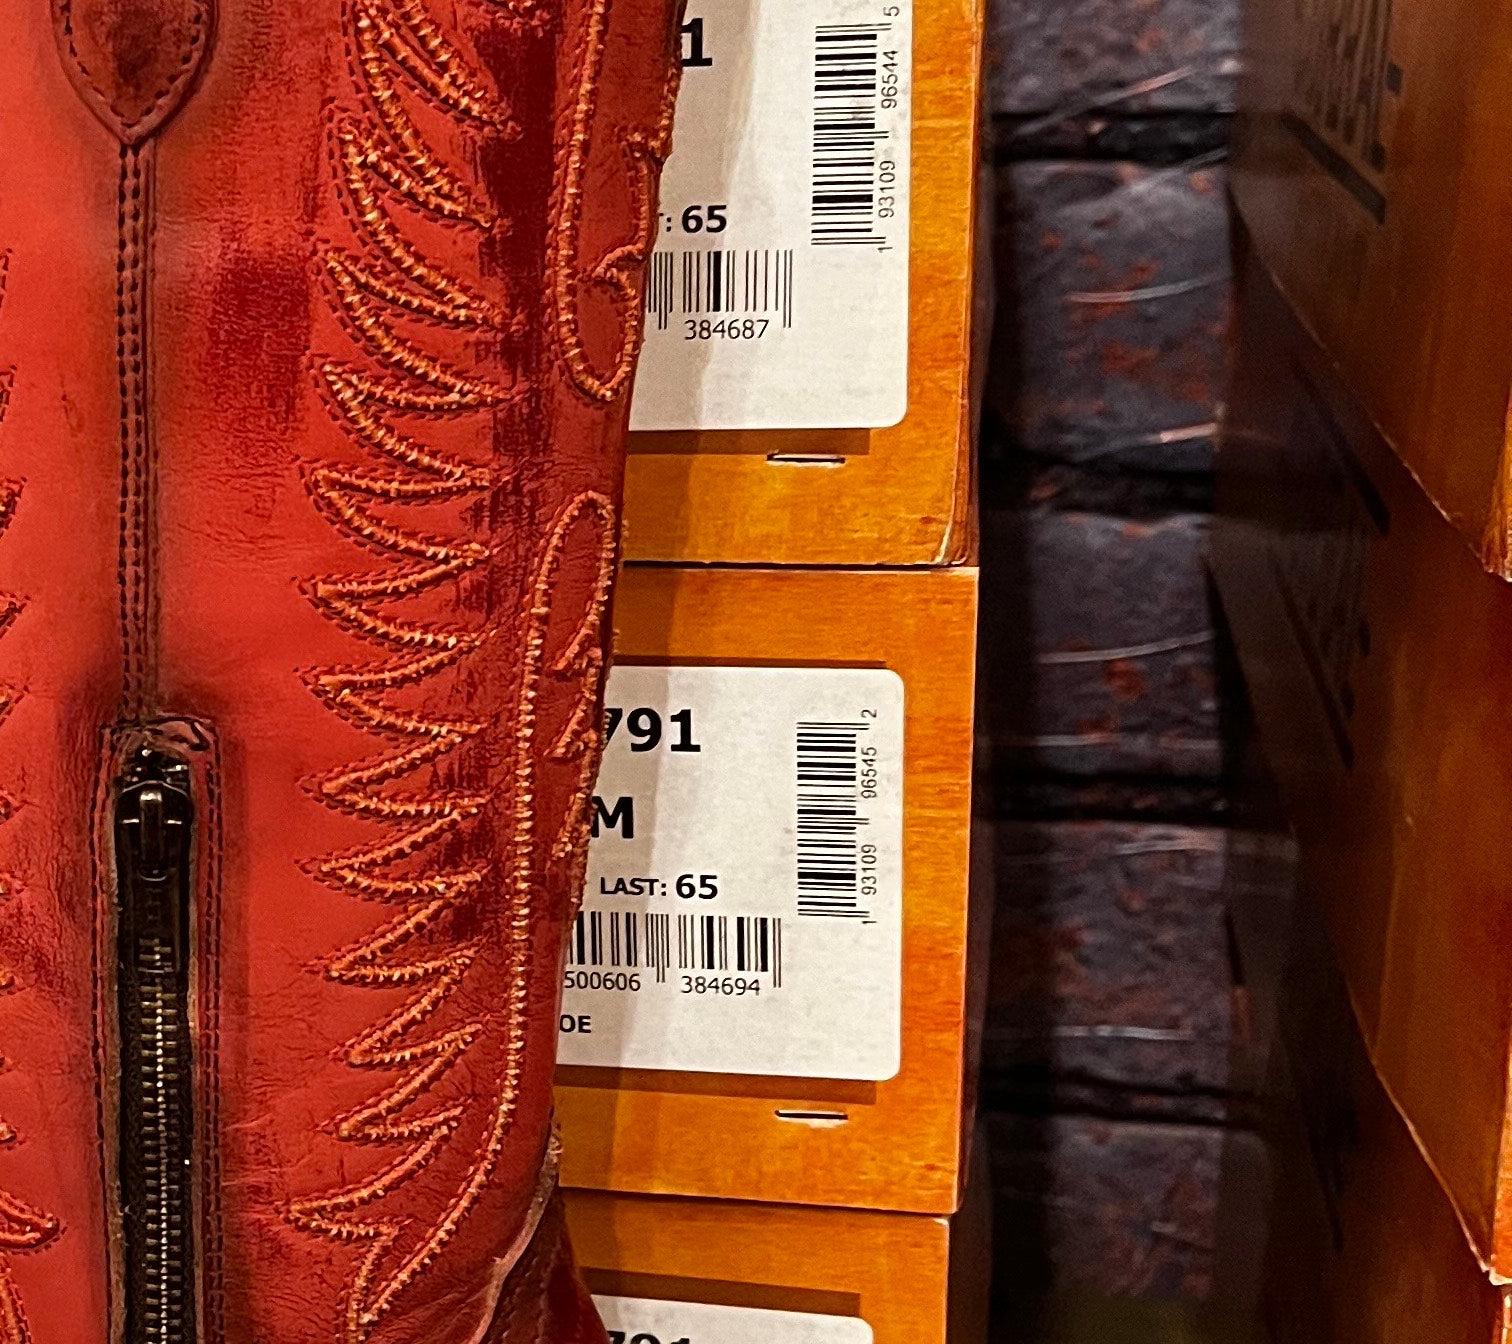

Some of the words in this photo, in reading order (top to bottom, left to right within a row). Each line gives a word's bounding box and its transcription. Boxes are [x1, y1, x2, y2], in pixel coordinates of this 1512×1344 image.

[883, 5, 899, 17] 5
[881, 50, 898, 109] 96544
[879, 160, 896, 218] 93109
[681, 205, 727, 234] 65
[683, 319, 769, 340] 384687
[861, 708, 878, 718] 2
[604, 708, 701, 752] 791
[861, 746, 878, 799] 96545
[591, 796, 634, 839] M
[860, 844, 877, 896] 93109
[600, 877, 667, 897] LAST:
[676, 874, 718, 900] 65
[564, 971, 641, 991] 500606
[681, 976, 761, 996] 384694
[559, 1014, 592, 1034] OE
